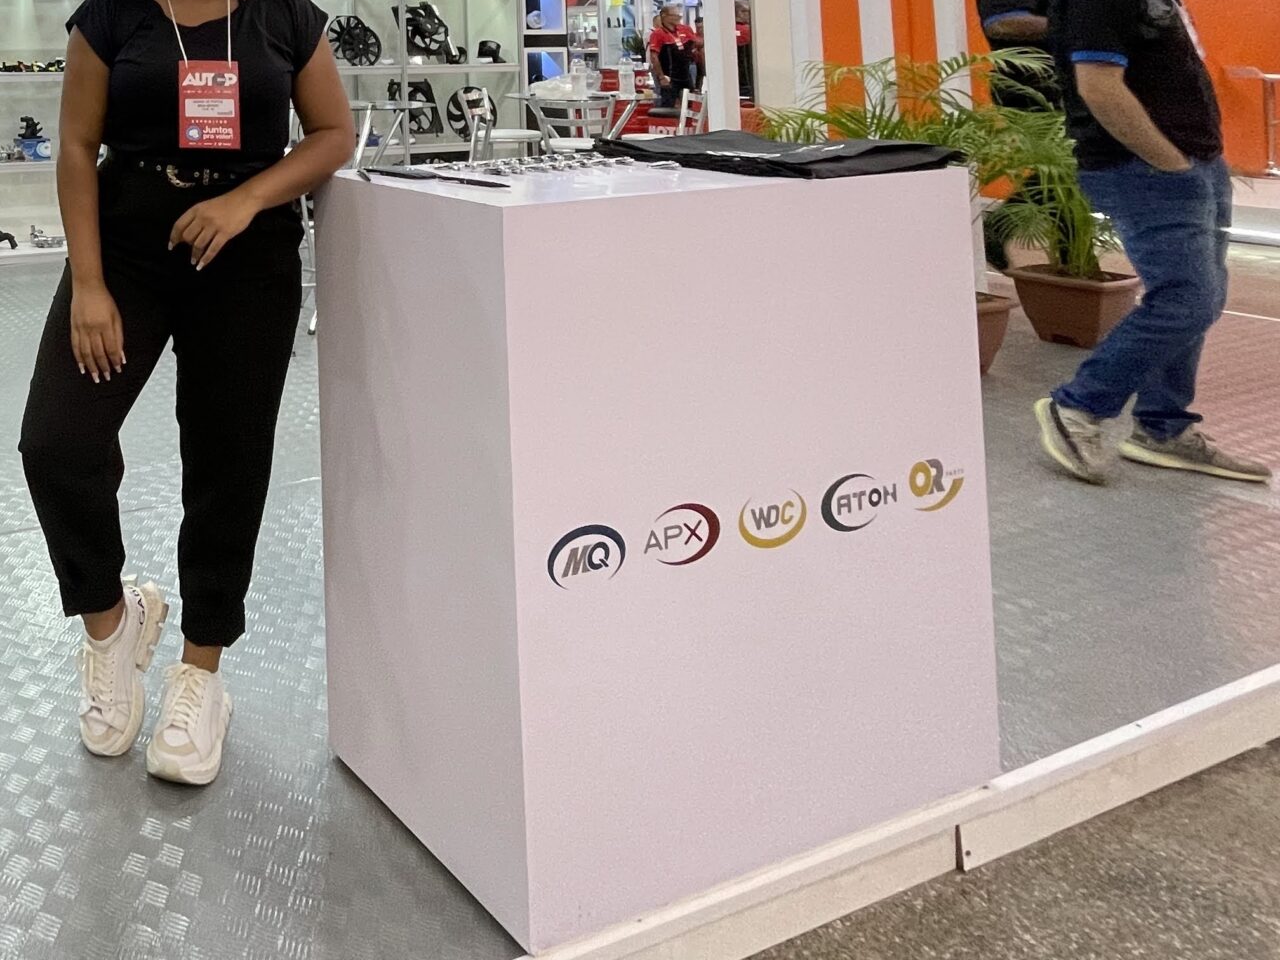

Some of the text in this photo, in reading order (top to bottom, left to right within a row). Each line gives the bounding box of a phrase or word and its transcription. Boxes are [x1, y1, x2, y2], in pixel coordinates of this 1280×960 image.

[203, 125, 234, 134] Juntos
[909, 459, 946, 497] OR
[750, 500, 795, 530] WDC
[836, 483, 898, 516] ATON
[644, 519, 704, 554] APX
[562, 540, 610, 578] MQ
